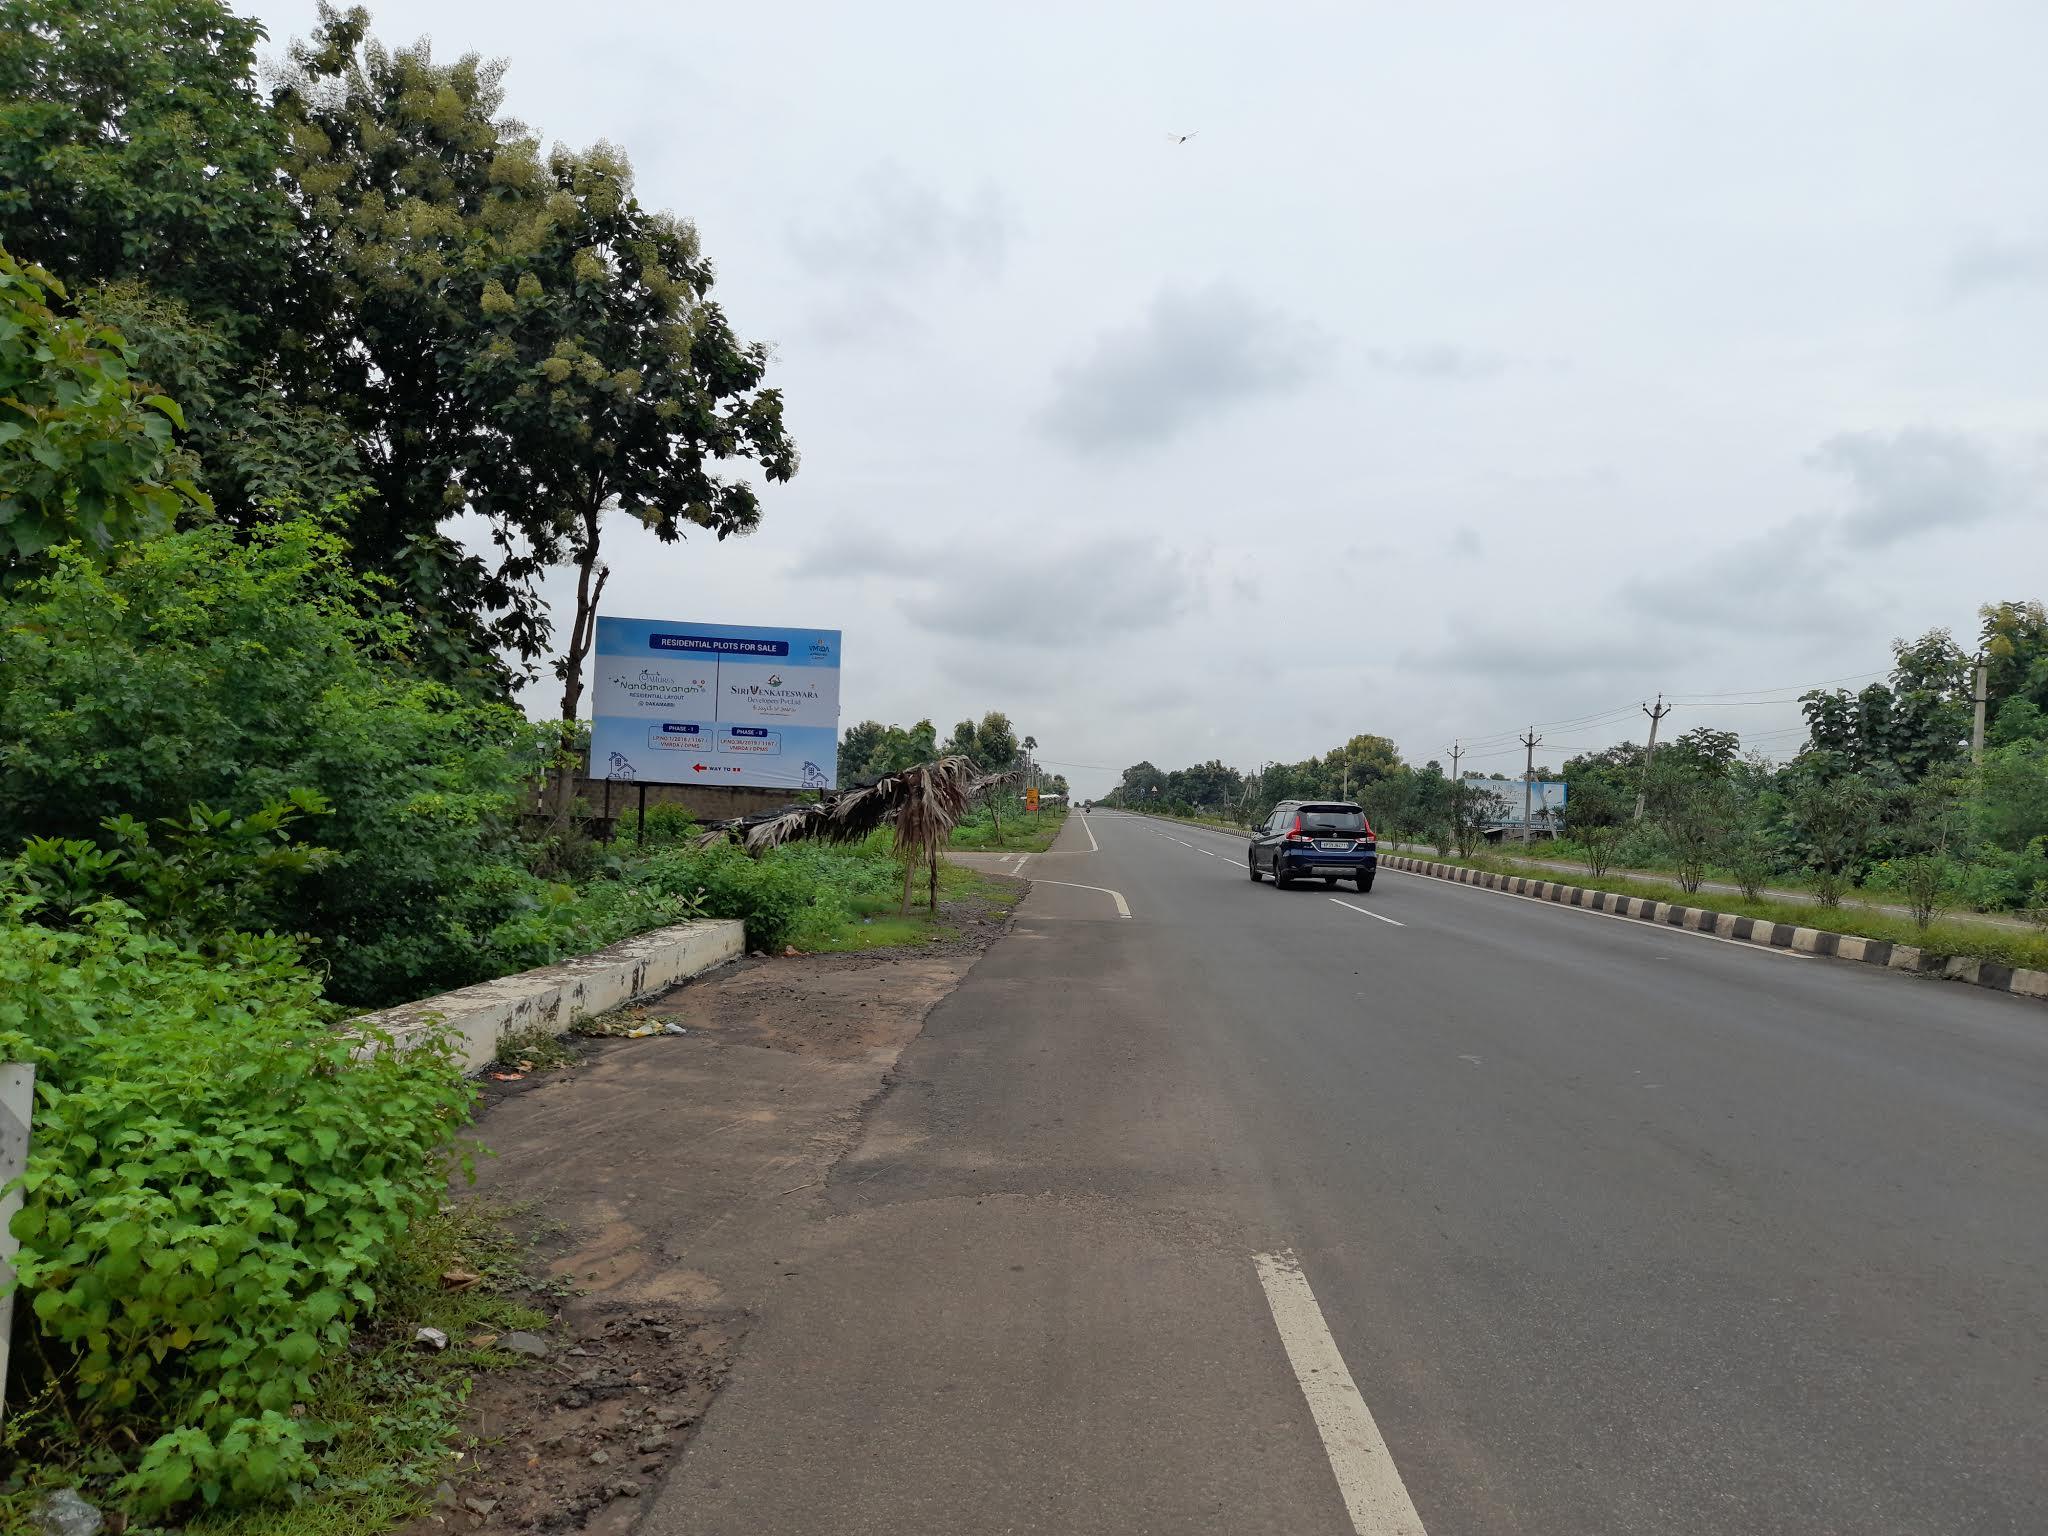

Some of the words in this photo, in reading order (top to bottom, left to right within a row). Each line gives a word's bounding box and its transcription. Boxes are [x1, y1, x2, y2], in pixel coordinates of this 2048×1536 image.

[661, 638, 711, 648] RESIDENTIAL
[713, 641, 739, 650] PLOTS
[740, 642, 755, 651] FOR
[756, 643, 777, 653] SALE
[620, 681, 699, 694] Nandanavanam
[747, 696, 779, 705] Developers
